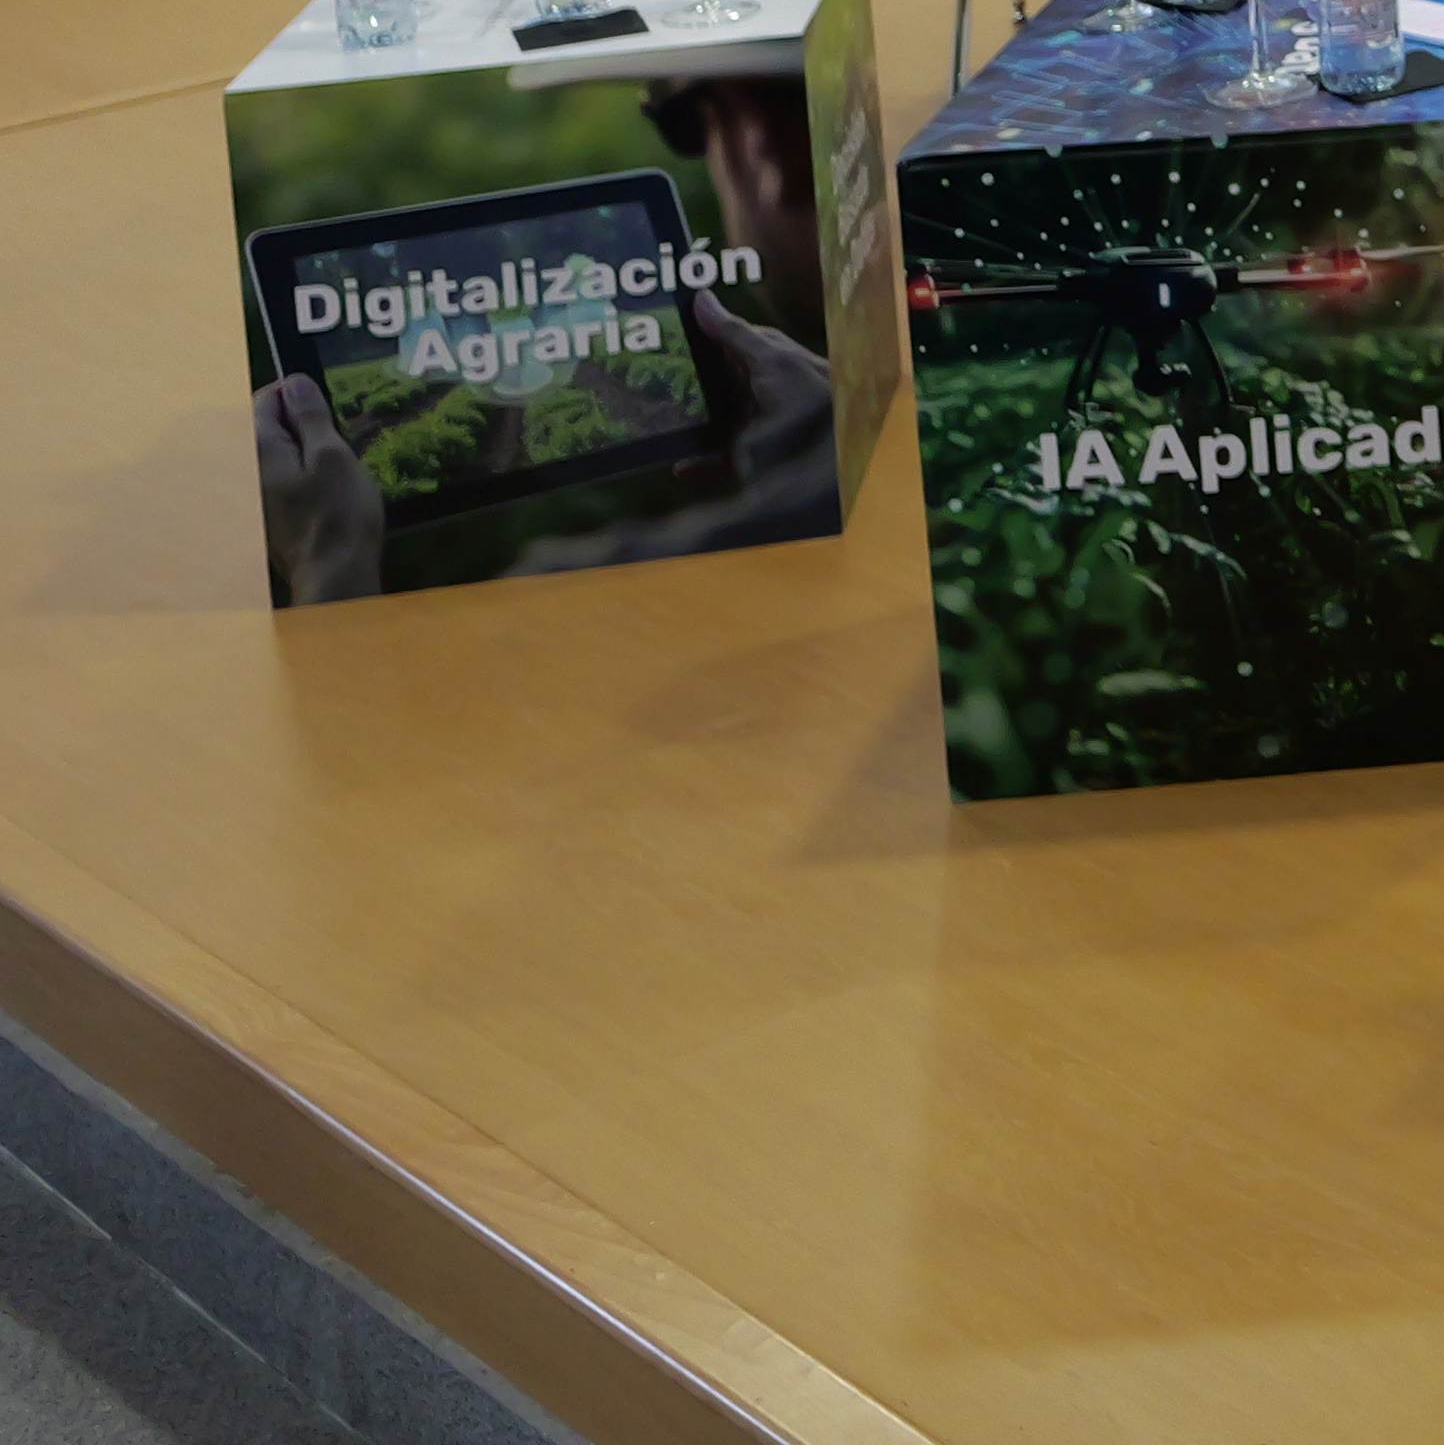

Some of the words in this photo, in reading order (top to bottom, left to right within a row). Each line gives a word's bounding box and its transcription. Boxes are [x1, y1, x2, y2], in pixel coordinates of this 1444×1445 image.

[294, 237, 763, 338] Digitalización
[408, 308, 662, 384] Agraria
[1038, 429, 1126, 492] IA
